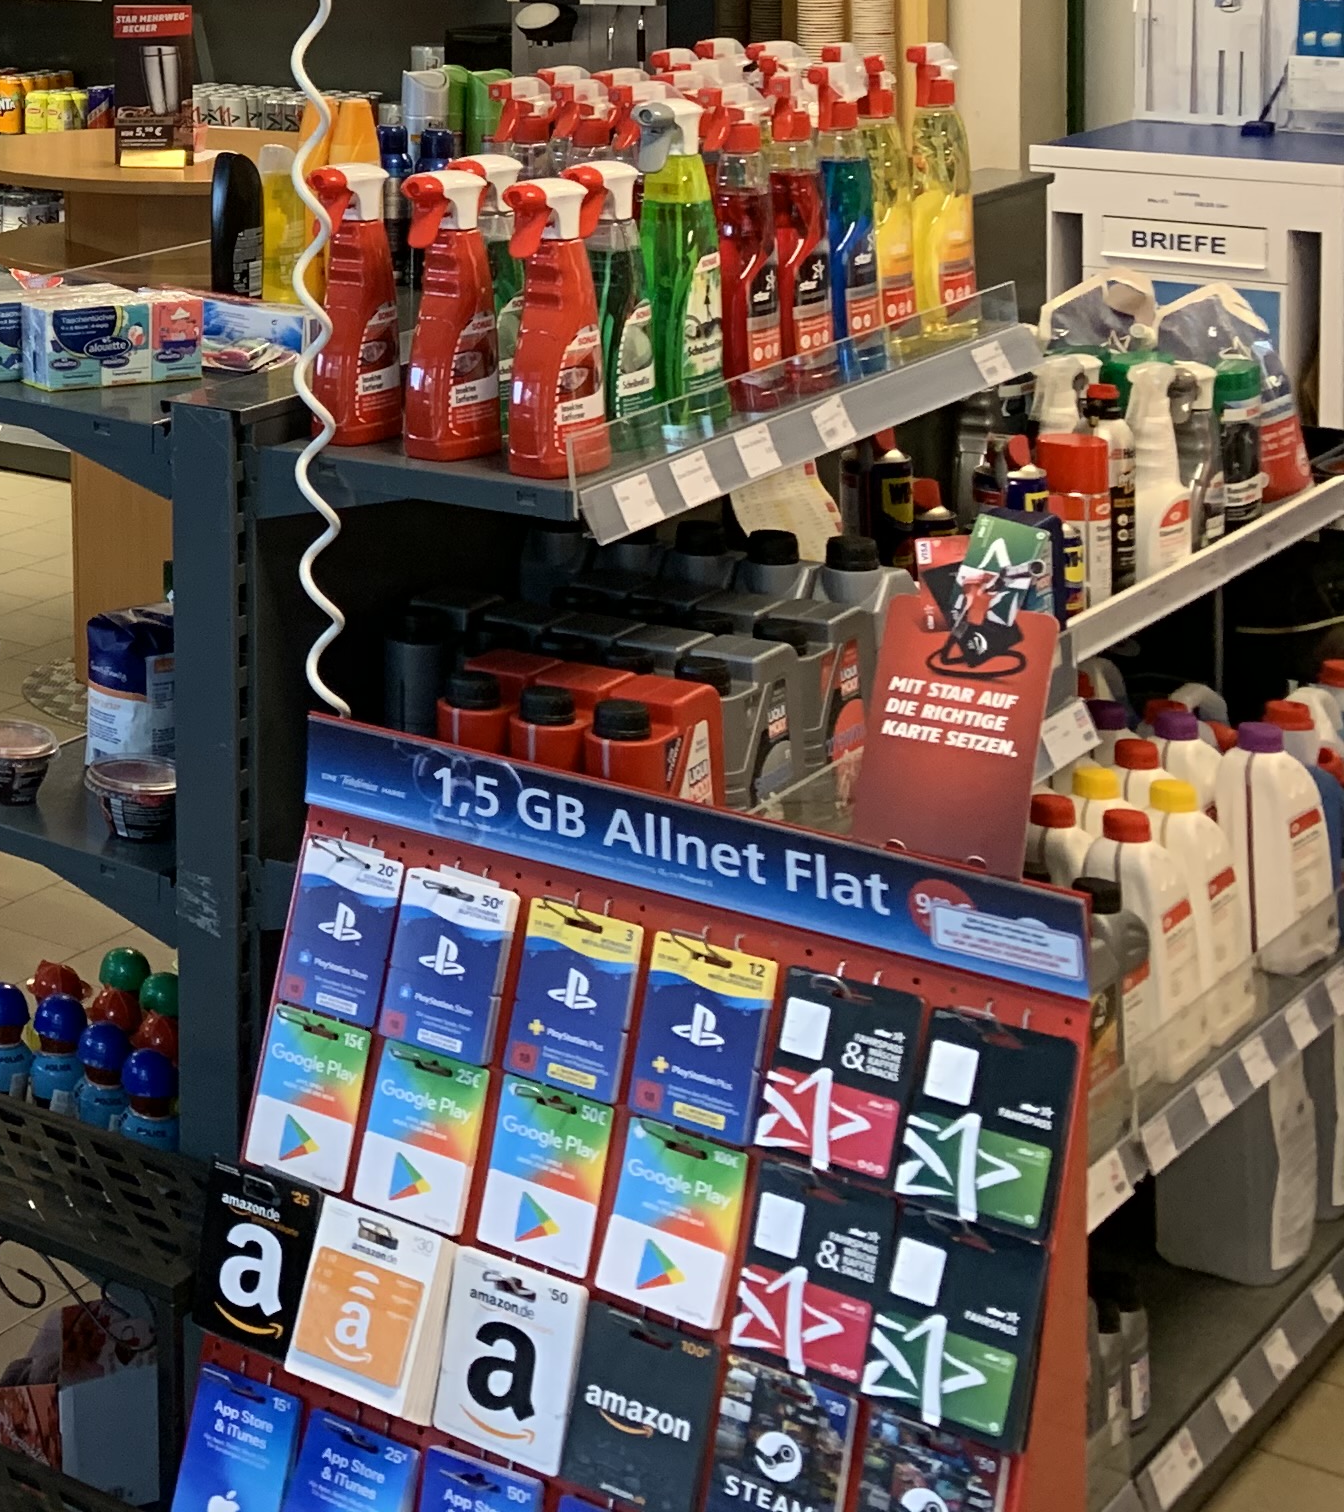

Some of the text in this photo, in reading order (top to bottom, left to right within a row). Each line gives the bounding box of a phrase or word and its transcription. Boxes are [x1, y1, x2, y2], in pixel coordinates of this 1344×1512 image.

[116, 15, 138, 24] STAR
[1130, 229, 1228, 256] BRIEFE
[88, 340, 127, 354] alouette
[888, 676, 1020, 711] MIT STAR AUF
[884, 697, 1009, 733] DIE RICHTIGE
[881, 719, 1020, 759] KARTE SETZEN.
[433, 766, 501, 819] 1,5
[516, 788, 587, 839] GB
[602, 806, 767, 886] Allnet
[785, 848, 892, 917] Flat
[625, 929, 634, 943] 3
[749, 961, 767, 978] 12
[343, 1032, 366, 1052] 15€
[271, 1042, 358, 1086] Google Play
[455, 1068, 482, 1090] 25€
[380, 1079, 473, 1125] Google Play
[581, 1104, 607, 1127] 50€
[998, 1107, 1054, 1131] FAHRSPASS
[502, 1115, 602, 1164] Google Play
[627, 1159, 733, 1211] Google Play
[222, 1191, 282, 1222] amazon.de
[219, 1222, 283, 1317] a
[469, 1287, 535, 1321] amazon.de
[213, 1399, 274, 1435] App Store
[584, 1382, 692, 1444] amazon
[214, 1420, 268, 1451] & iTunes
[321, 1447, 386, 1485] App Store
[334, 1471, 376, 1500] iTunes
